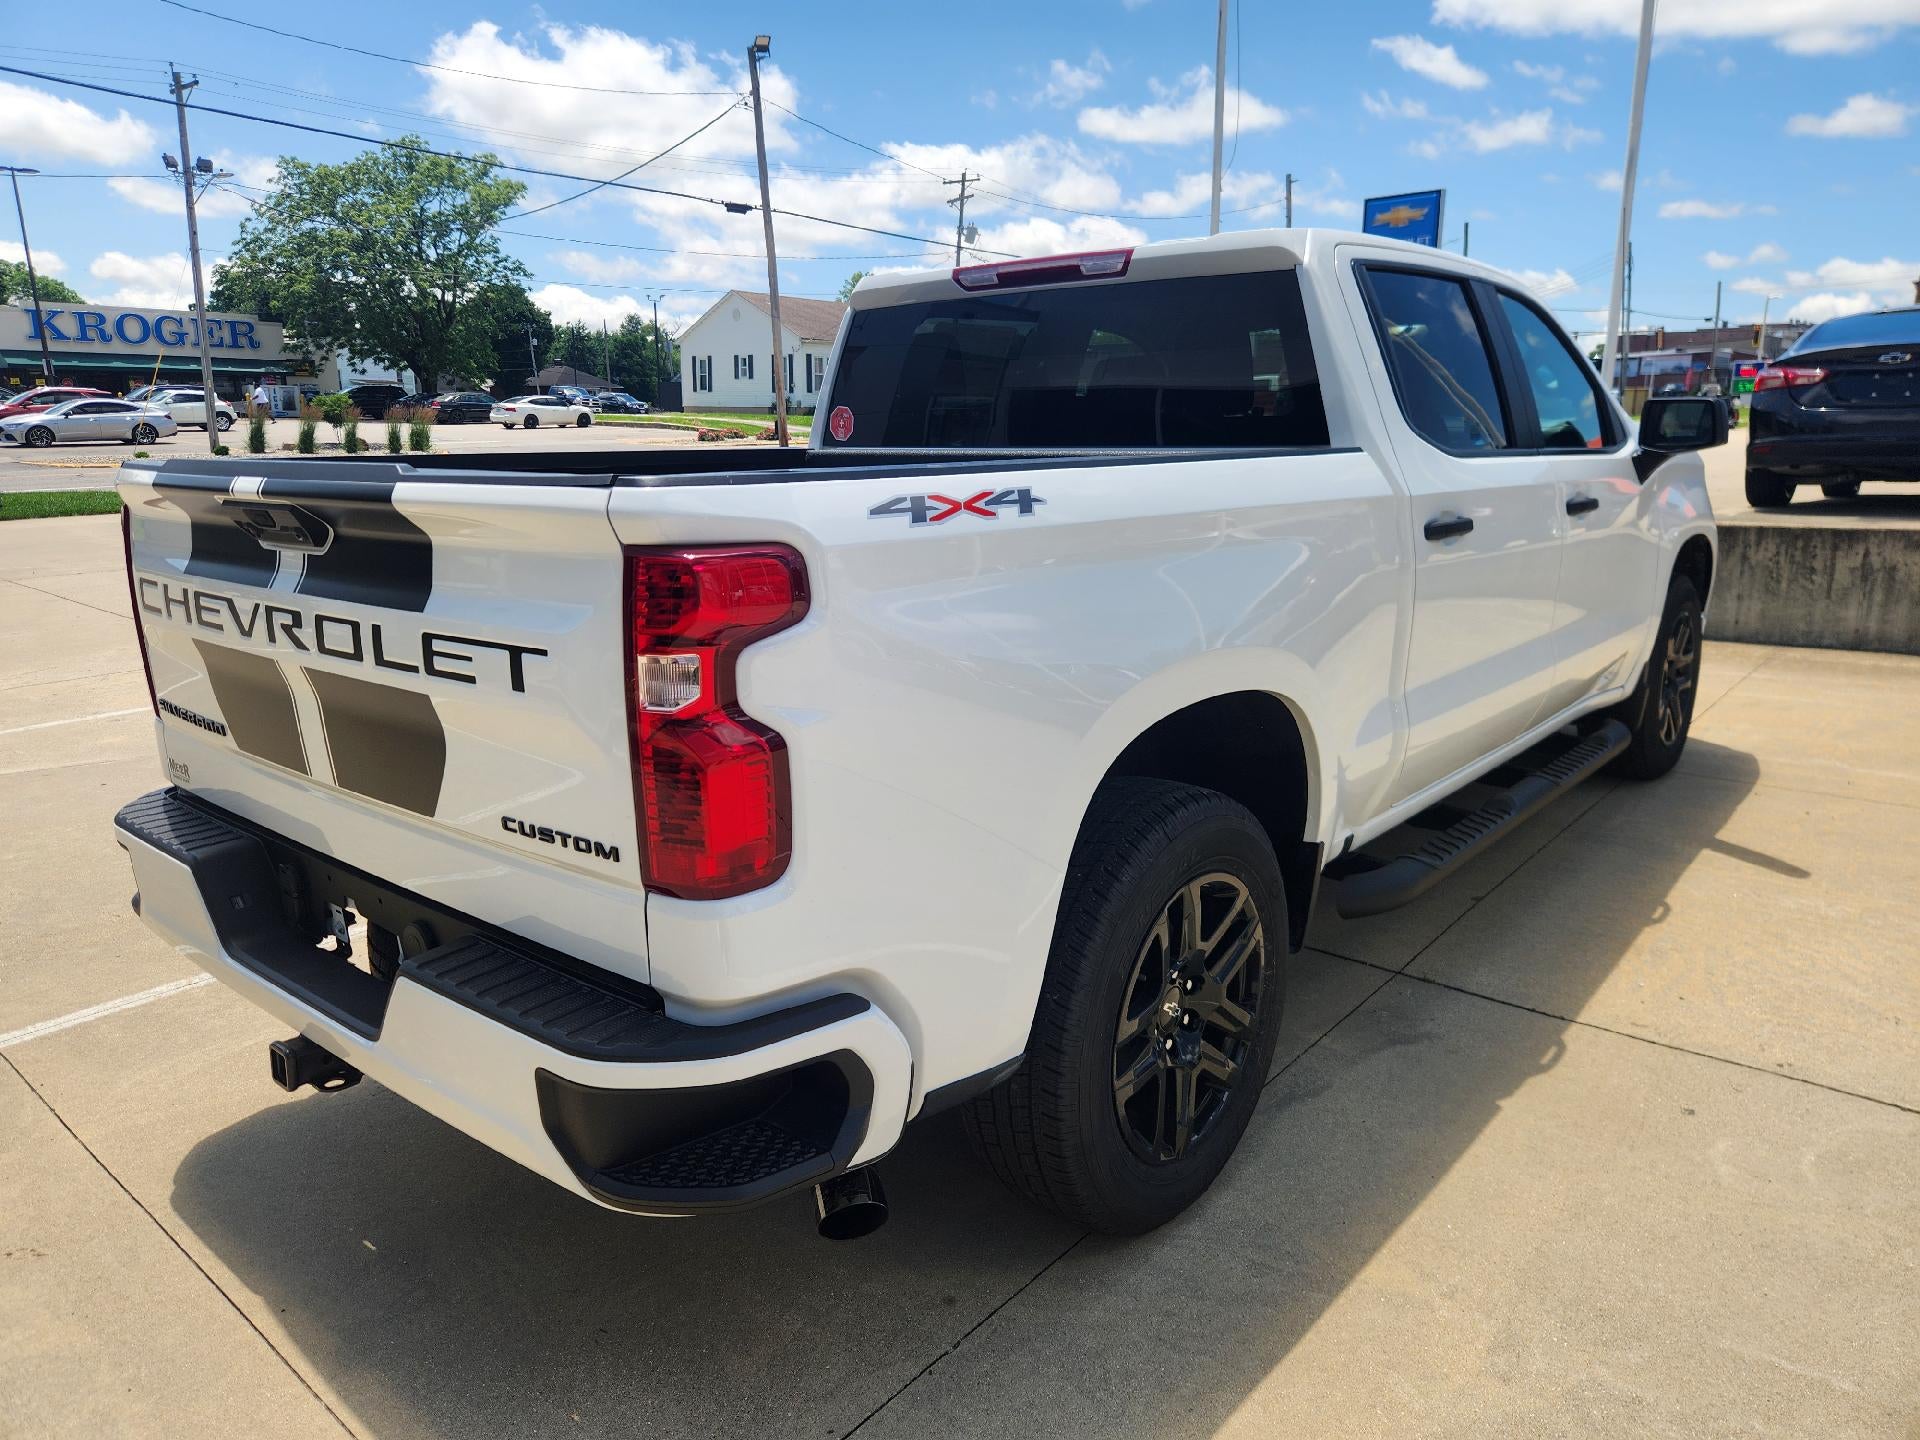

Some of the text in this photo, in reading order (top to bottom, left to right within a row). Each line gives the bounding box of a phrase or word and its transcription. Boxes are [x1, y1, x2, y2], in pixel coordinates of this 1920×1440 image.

[24, 308, 261, 350] KROGER
[139, 576, 548, 694] CHEVROLET
[500, 815, 620, 862] CUSTOM
